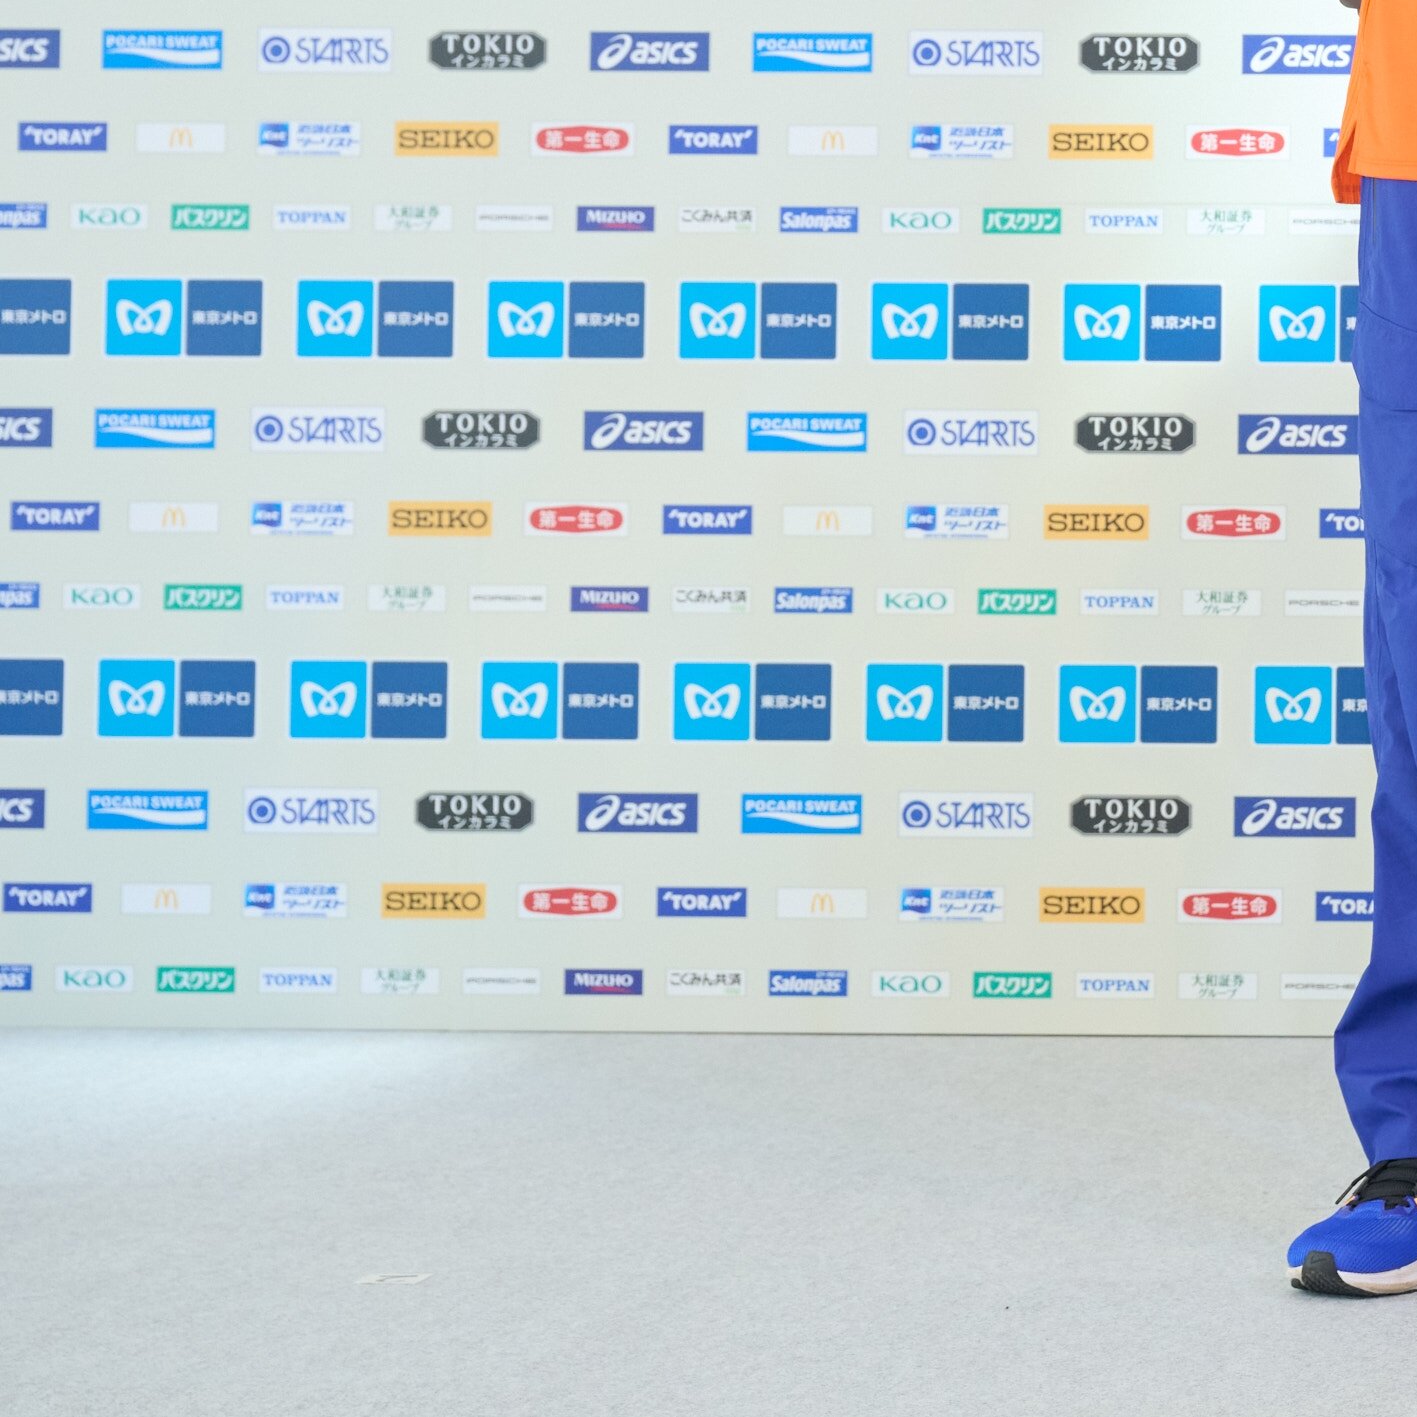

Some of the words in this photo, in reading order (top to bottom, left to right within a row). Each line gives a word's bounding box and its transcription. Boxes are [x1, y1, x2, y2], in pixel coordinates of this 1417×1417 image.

[442, 35, 533, 54] TOKIO
[452, 55, 524, 67] インカラミ
[1053, 132, 1149, 151] SEIKO
[1201, 133, 1275, 151] 第一生命
[1280, 424, 1347, 447] asics
[619, 802, 686, 825] asics
[387, 892, 481, 910] SEIKO
[533, 892, 607, 910] 第一生命
[1080, 979, 1149, 992] TOPPAN
